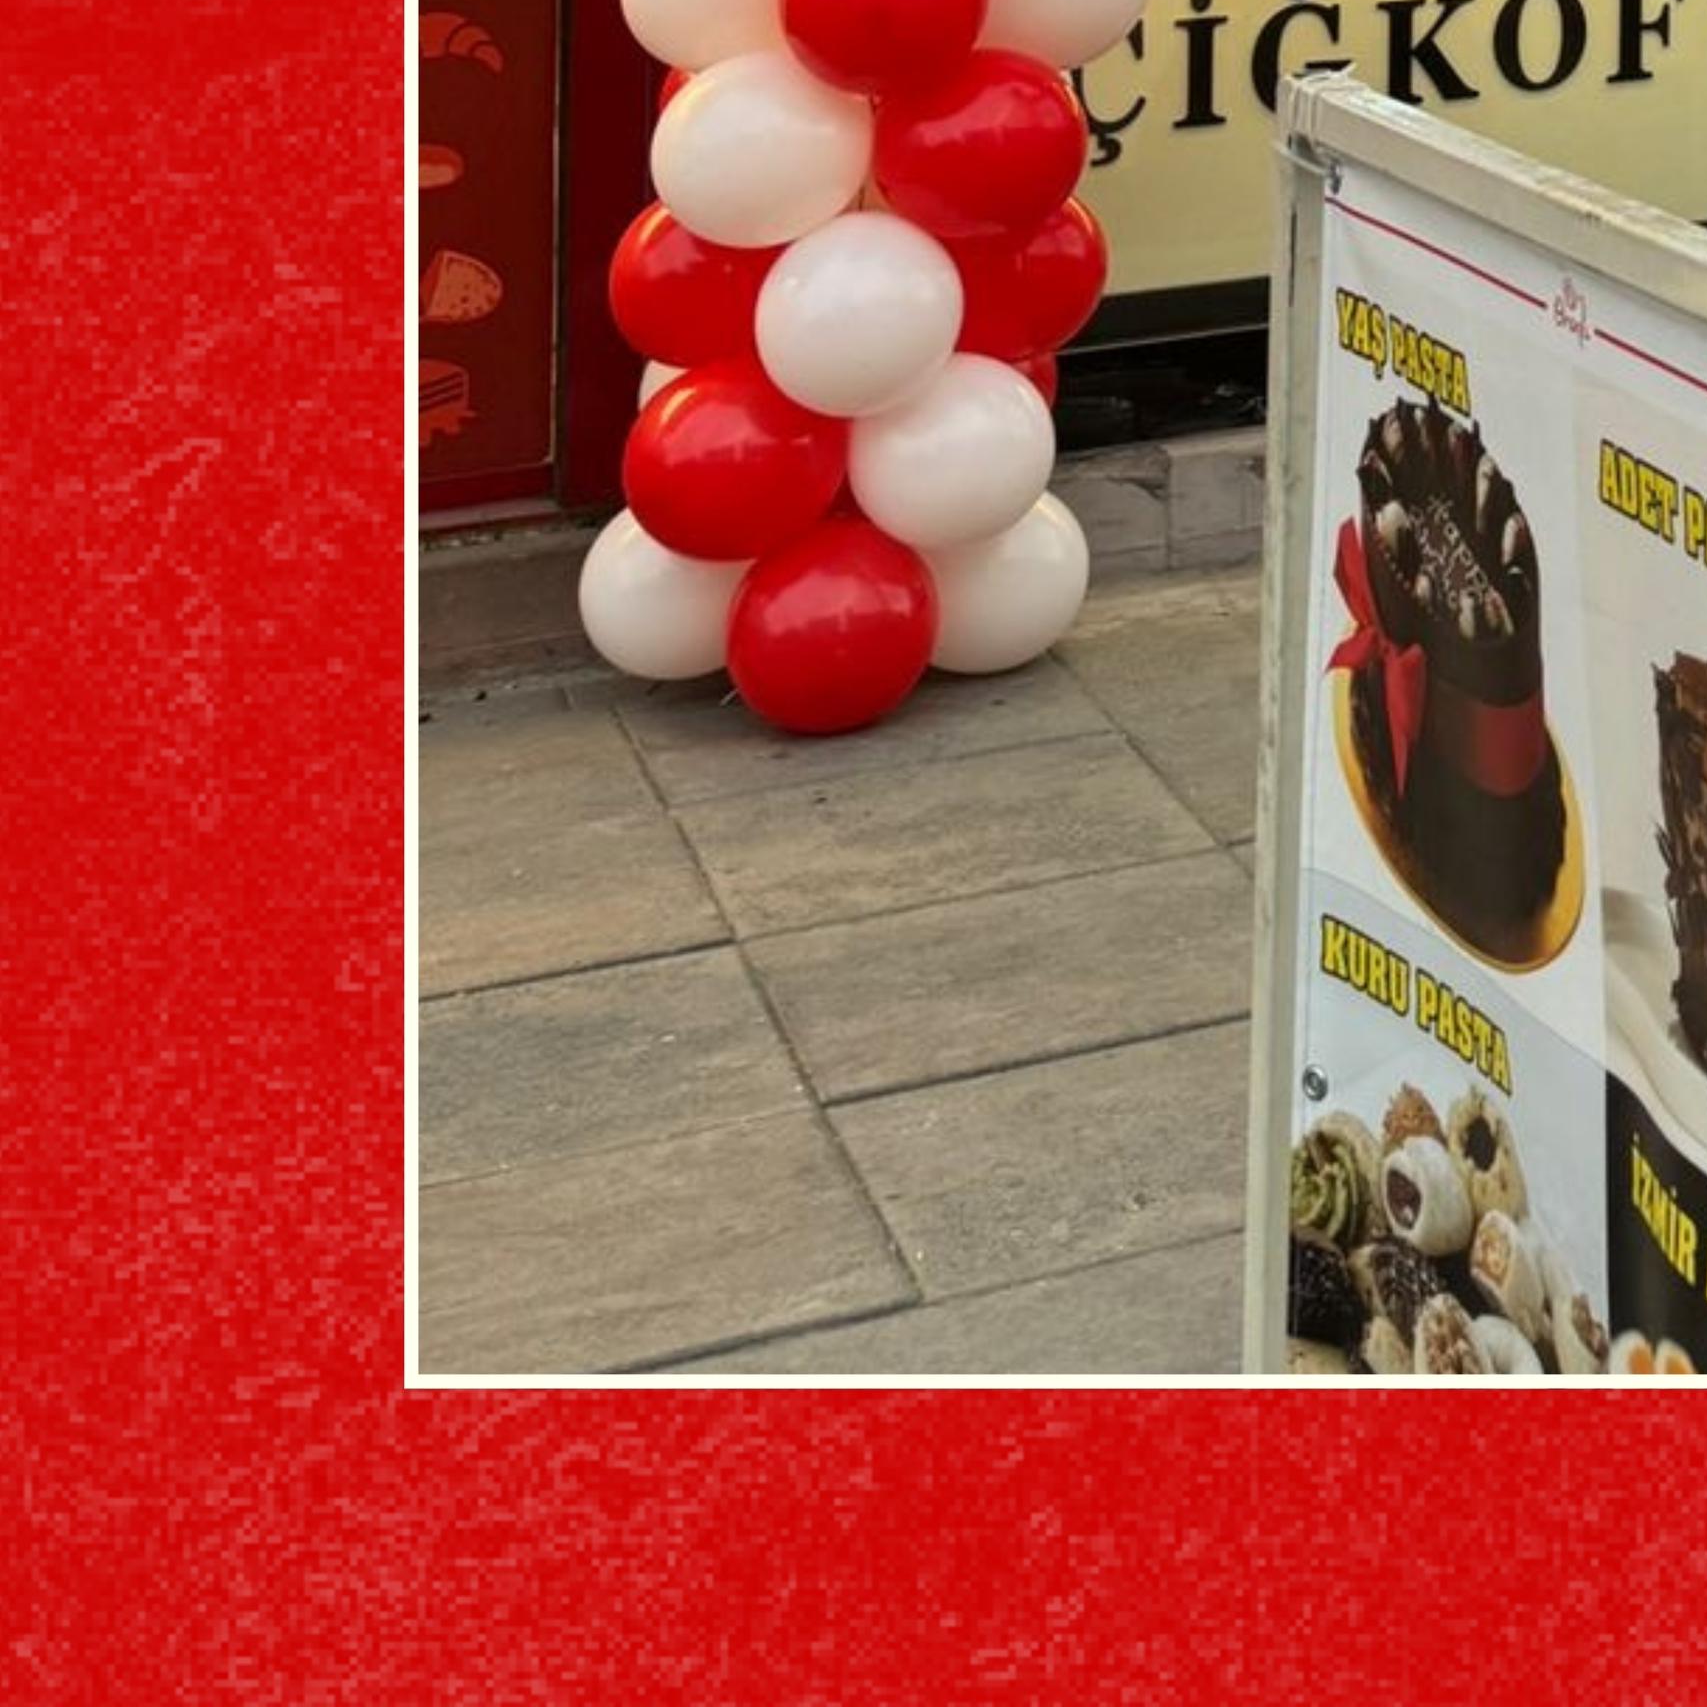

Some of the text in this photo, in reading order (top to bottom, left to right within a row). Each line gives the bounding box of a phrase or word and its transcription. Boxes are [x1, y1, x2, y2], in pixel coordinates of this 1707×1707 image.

[1335, 288, 1472, 417] YAŞ PASTA
[1598, 439, 1677, 544] ADET
[1321, 914, 1513, 1097] KURU PASTA
[1630, 1134, 1698, 1286] İZMİR
